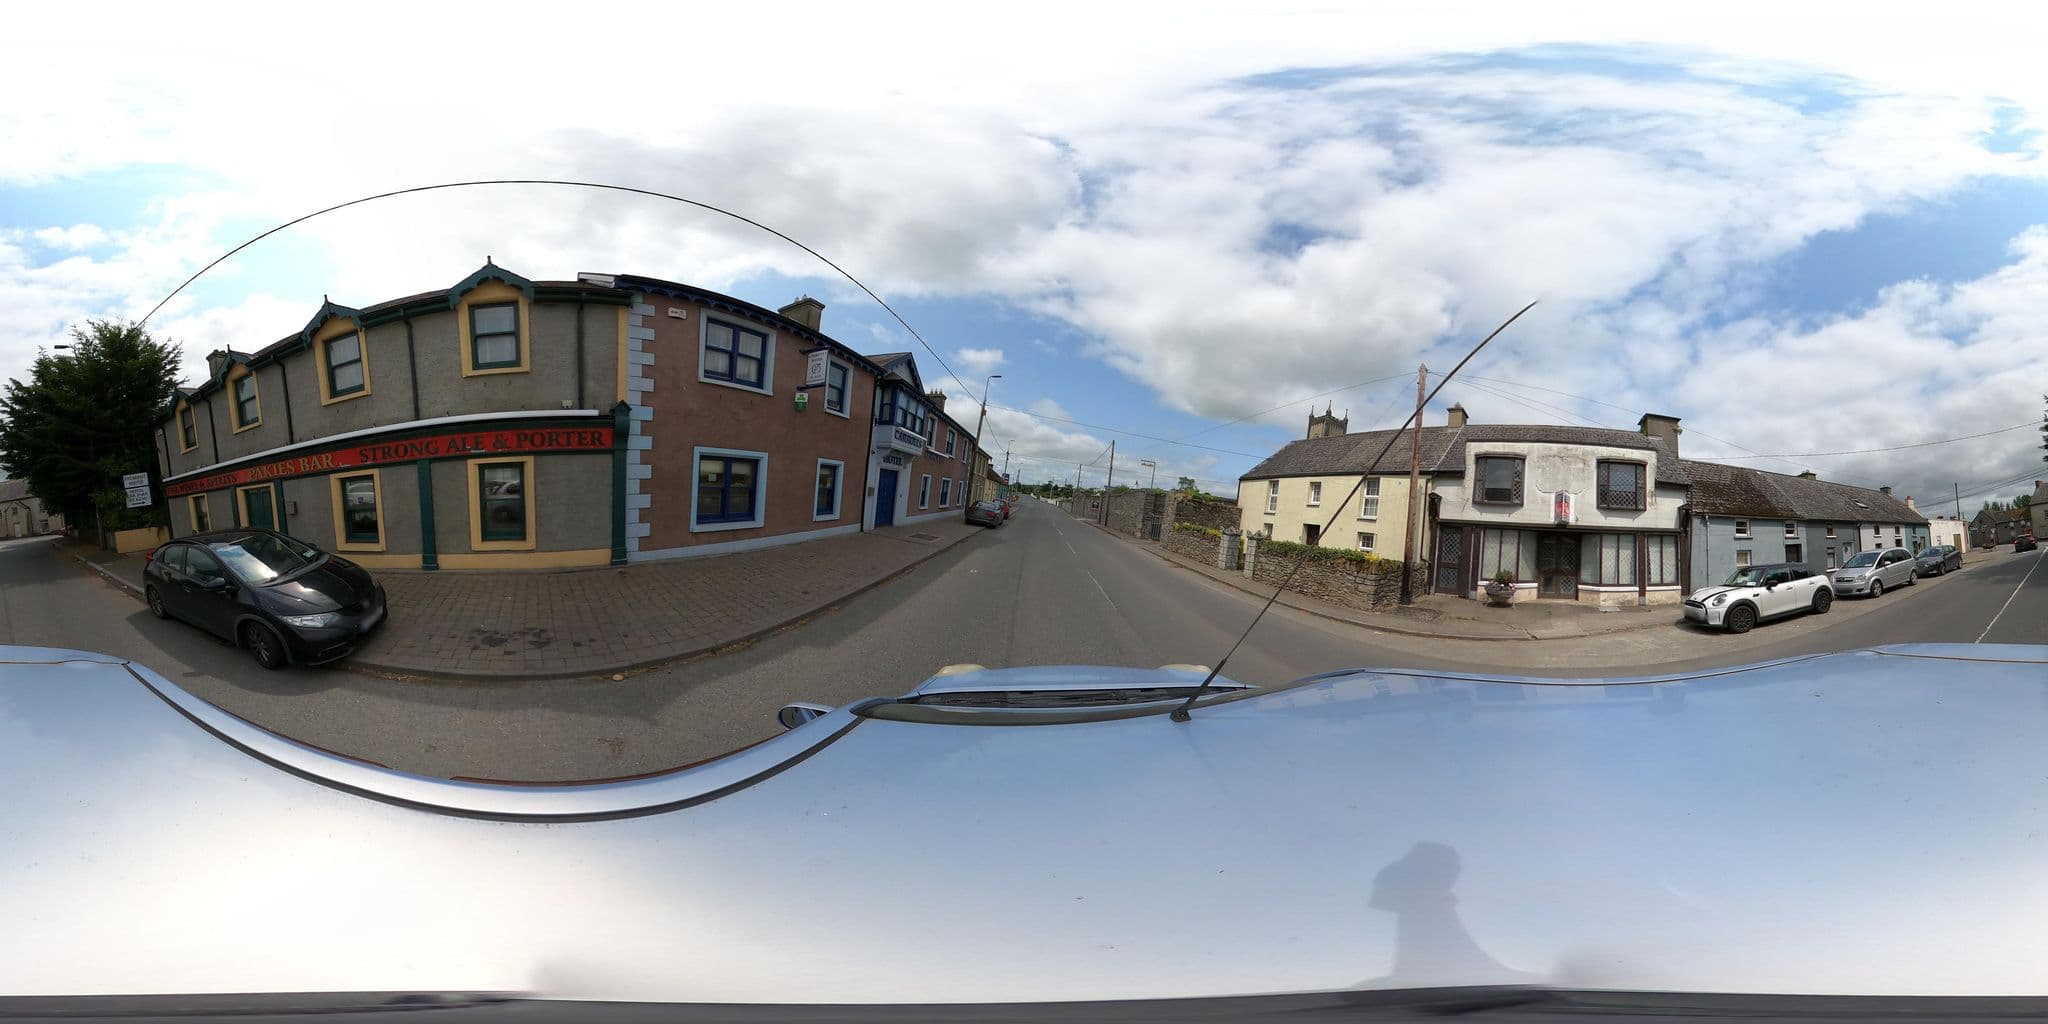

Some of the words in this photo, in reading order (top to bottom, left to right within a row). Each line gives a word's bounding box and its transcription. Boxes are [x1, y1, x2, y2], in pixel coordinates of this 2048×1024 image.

[359, 439, 439, 464] STRONG
[447, 434, 482, 452] ALE
[493, 433, 510, 450] &
[515, 430, 606, 448] PORTER
[883, 455, 903, 466] HOTEL
[249, 461, 295, 481] PAKIES
[300, 454, 336, 473] BAR
